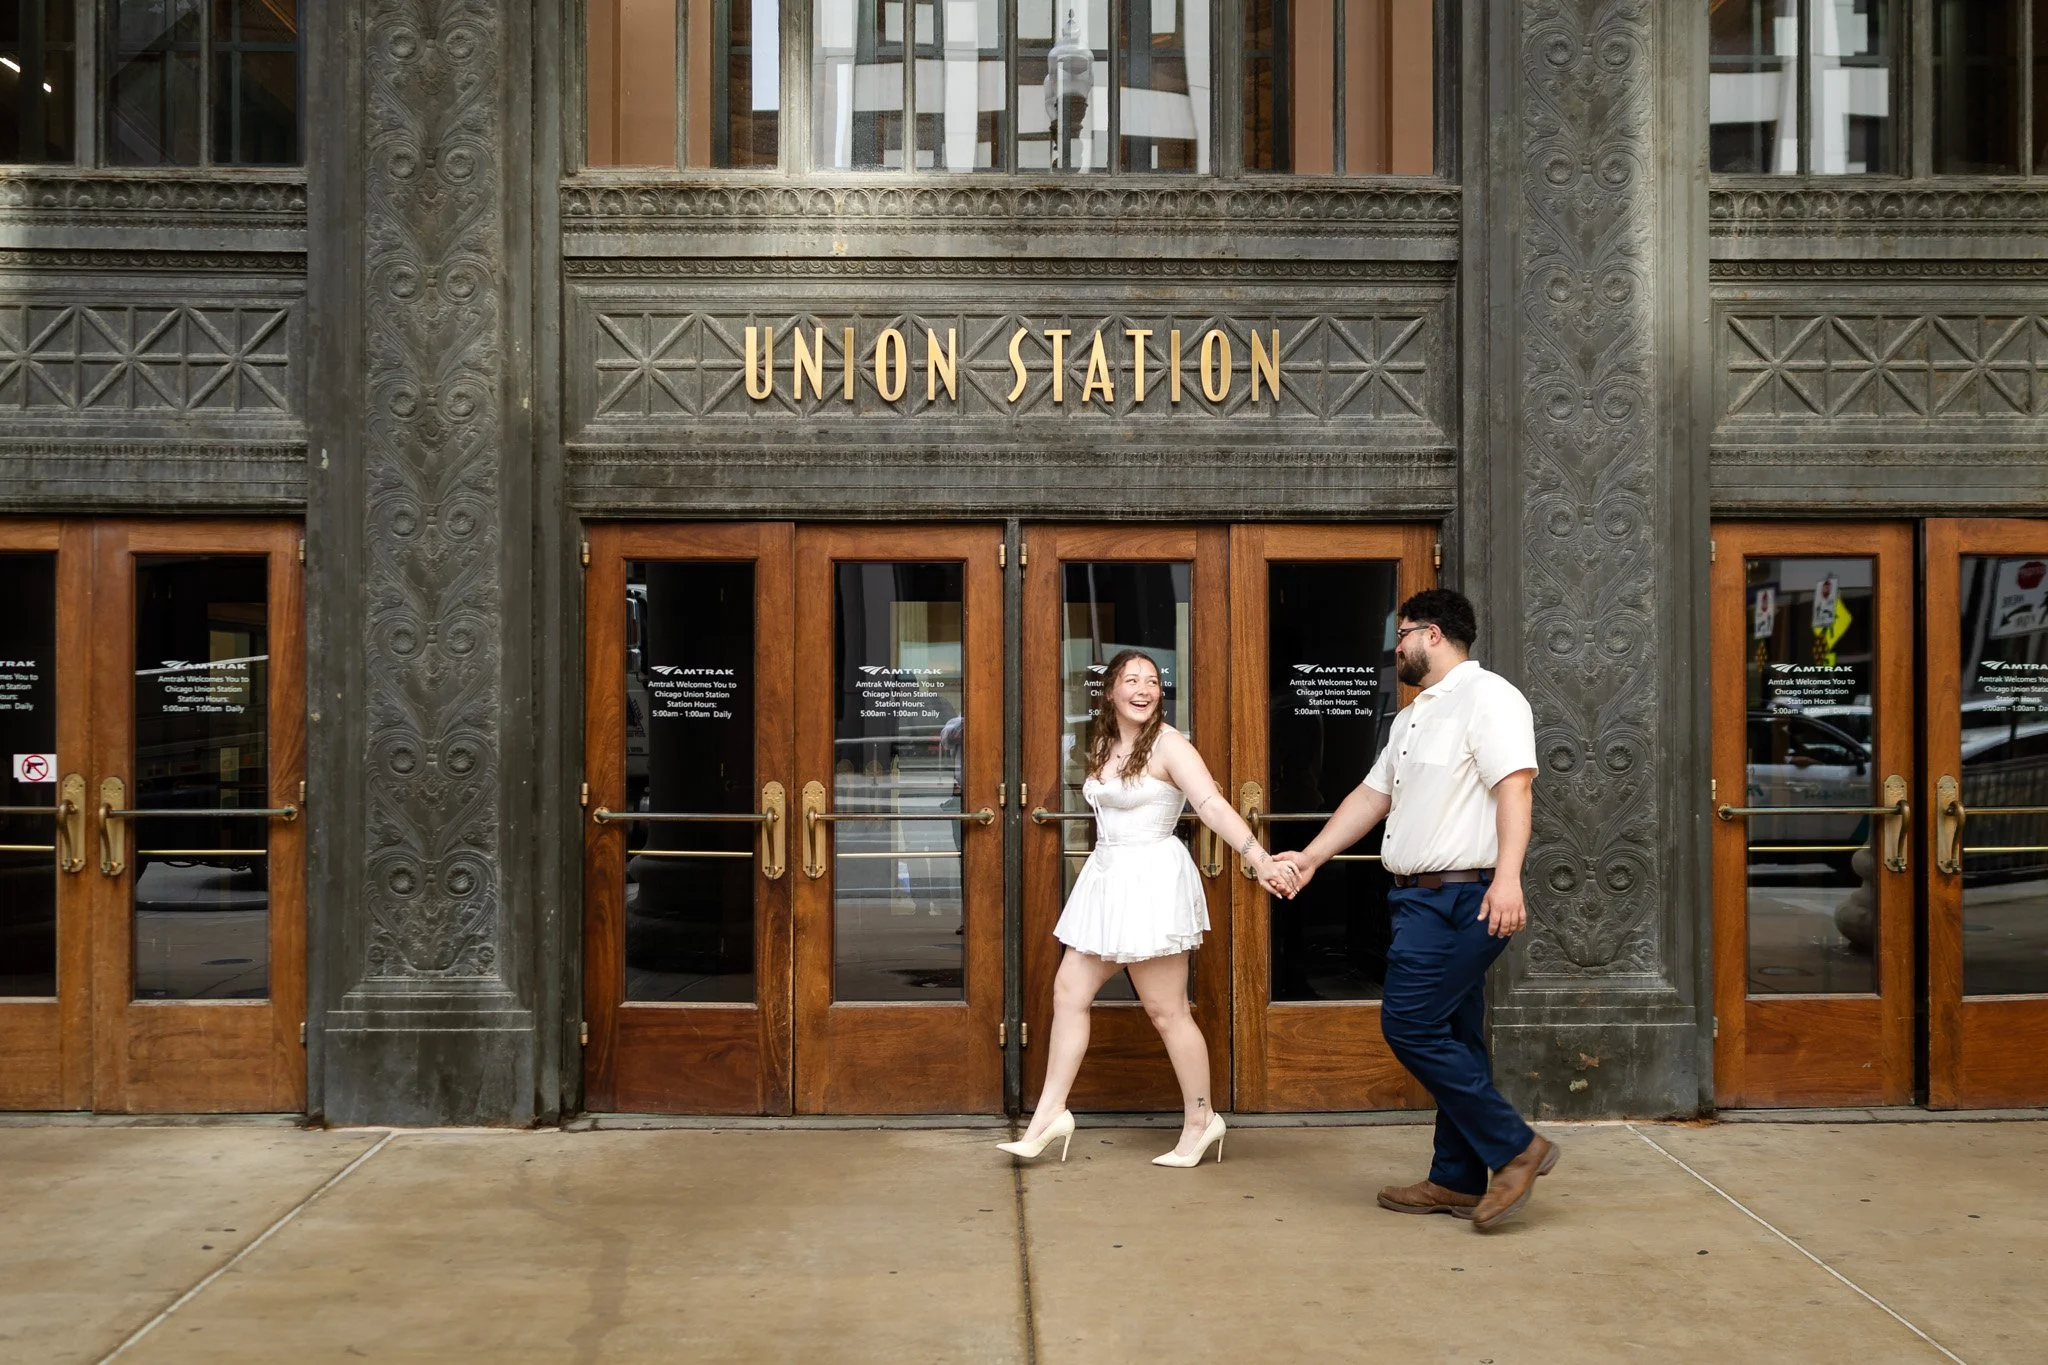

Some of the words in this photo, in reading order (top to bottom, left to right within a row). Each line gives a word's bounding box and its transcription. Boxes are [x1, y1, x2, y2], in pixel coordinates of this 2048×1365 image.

[745, 326, 956, 401] UNION
[1007, 328, 1280, 402] STATION
[164, 686, 193, 694] Chicago
[1296, 689, 1323, 697] Chicago
[1774, 688, 1801, 696] Chicago
[654, 691, 682, 699] Chicago
[862, 691, 889, 699] Chicago
[15, 703, 34, 711] Daily
[713, 711, 732, 719] Daily
[921, 710, 940, 718] Daily
[1355, 709, 1373, 717] Daily
